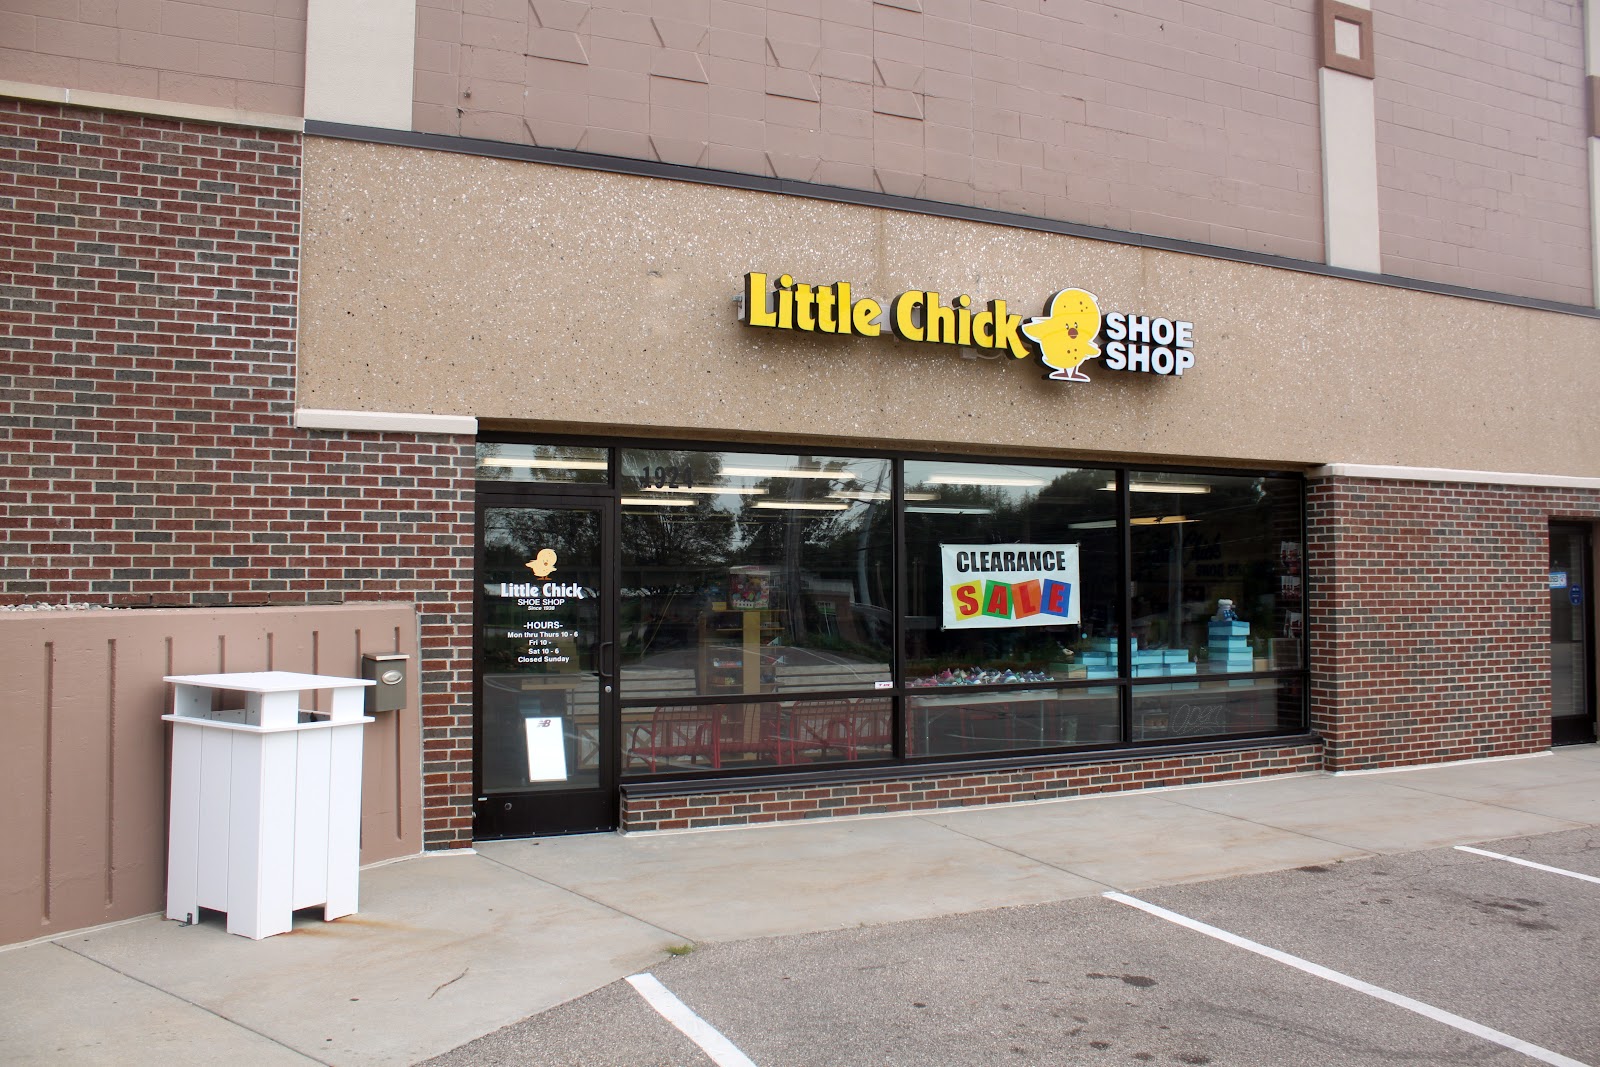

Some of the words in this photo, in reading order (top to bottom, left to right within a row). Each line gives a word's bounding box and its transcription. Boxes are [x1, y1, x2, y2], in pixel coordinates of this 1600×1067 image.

[747, 271, 883, 338] Little
[894, 289, 1030, 360] Chick
[1105, 311, 1195, 349] SHOE
[1105, 341, 1196, 377] SHOP
[642, 466, 693, 488] 1924
[956, 550, 1066, 573] CLEARANCE
[500, 582, 539, 598] Little
[542, 582, 585, 600] Chick
[956, 582, 1066, 616] SALE
[544, 655, 570, 663] Sunday
